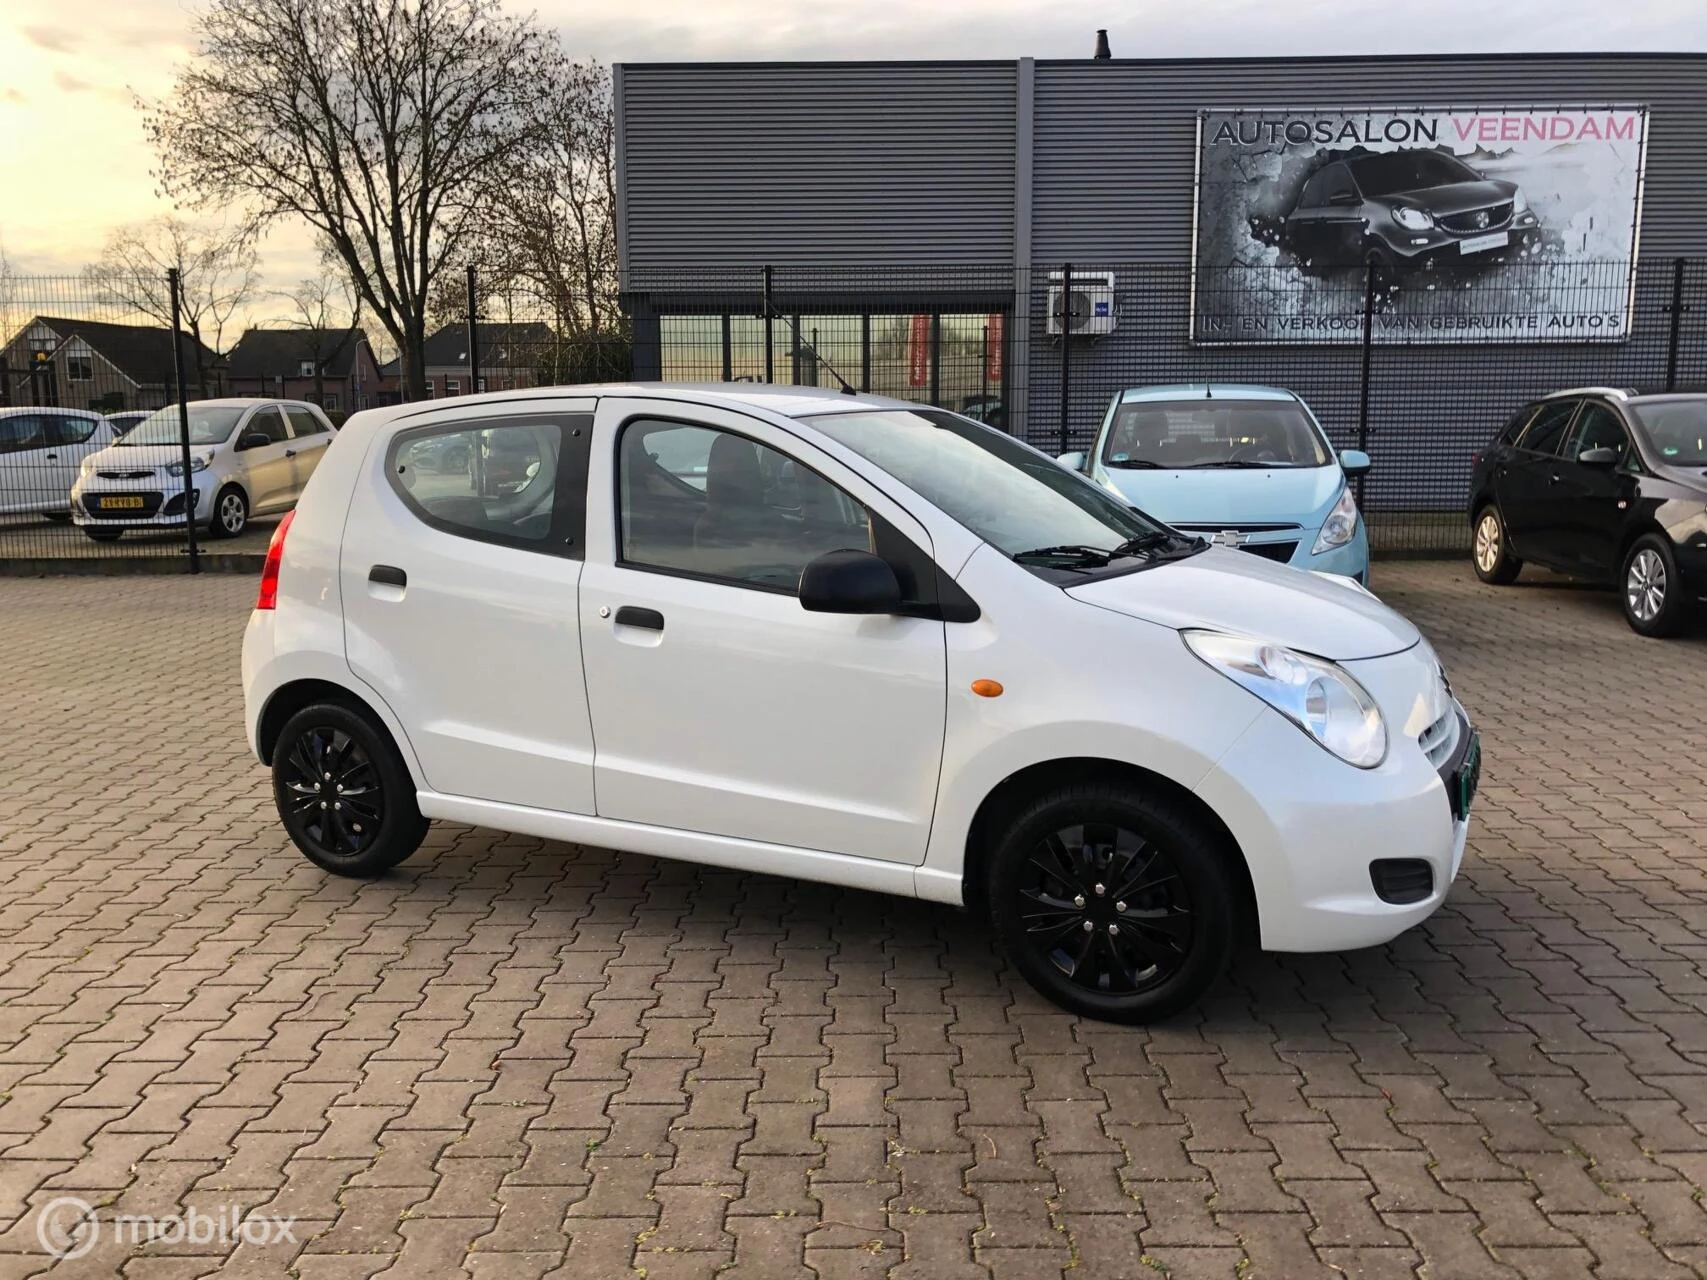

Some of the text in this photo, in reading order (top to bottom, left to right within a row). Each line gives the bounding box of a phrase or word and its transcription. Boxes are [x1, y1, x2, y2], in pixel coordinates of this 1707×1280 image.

[1210, 116, 1635, 145] AUTOSALON VEENDAM
[1242, 315, 1267, 331] EN
[1379, 316, 1419, 330] VAN
[1429, 314, 1538, 331] GEBRUIKTE
[1548, 311, 1619, 329] AUTO'S
